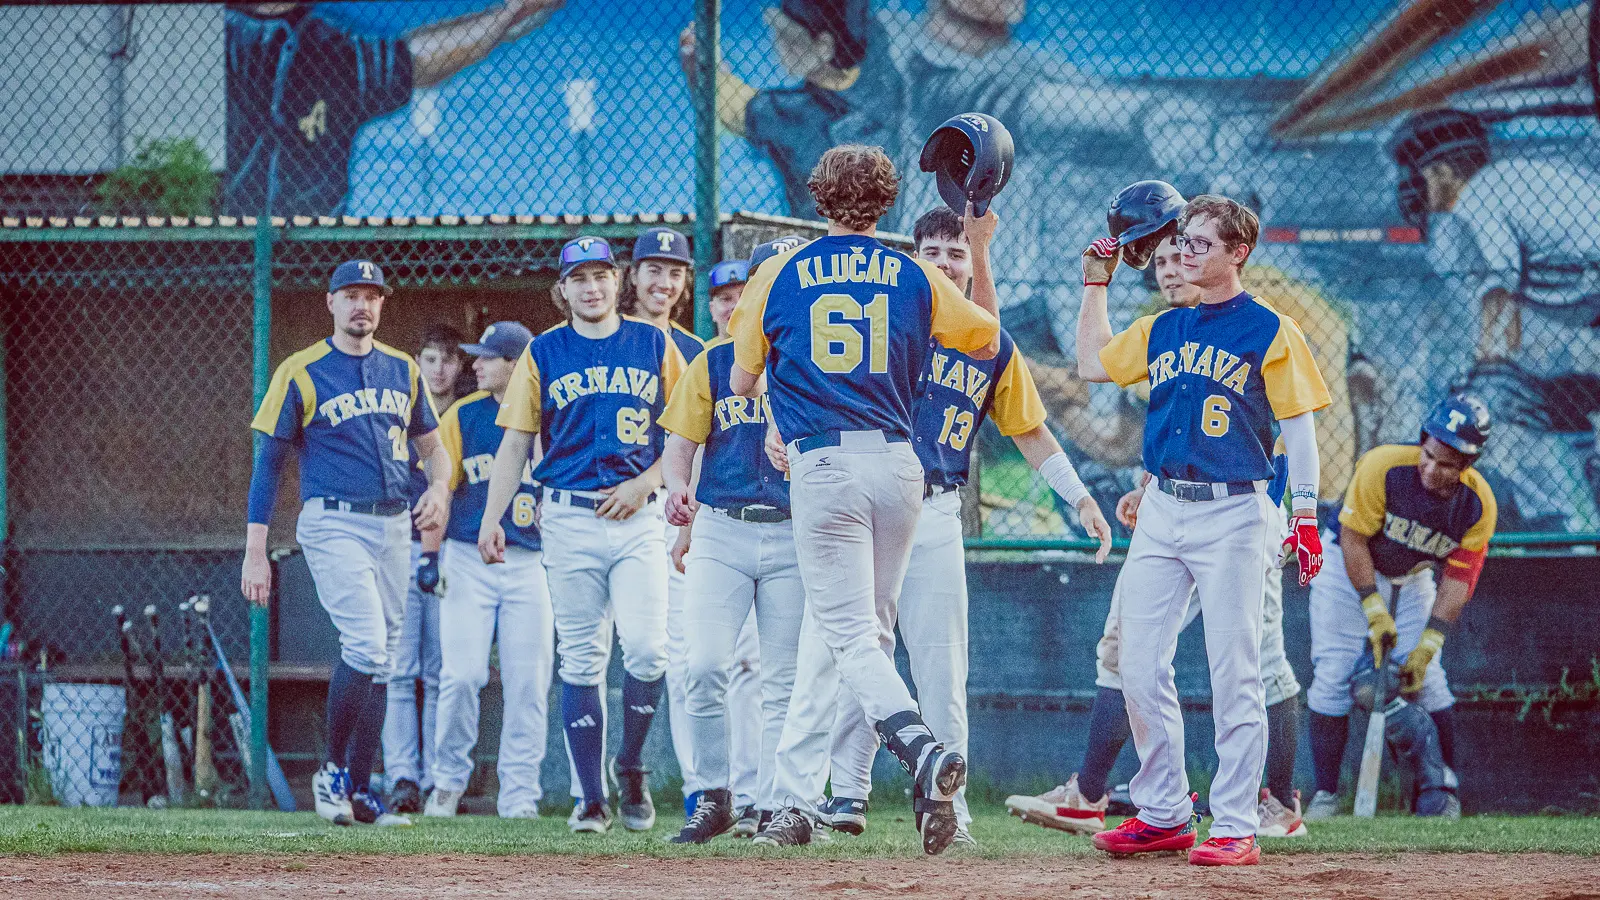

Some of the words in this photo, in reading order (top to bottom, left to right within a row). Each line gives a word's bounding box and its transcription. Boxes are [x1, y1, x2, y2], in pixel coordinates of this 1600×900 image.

[657, 232, 675, 251] T
[358, 262, 374, 280] T
[796, 247, 902, 289] KLUČÁR
[810, 294, 888, 373] 61
[548, 366, 658, 410] TRNAVA
[919, 352, 990, 410] NAVA
[1148, 341, 1251, 395] TRNAVA
[617, 407, 650, 446] 62
[714, 394, 771, 431] TRN
[938, 405, 974, 451] 13
[1201, 395, 1231, 437] 6
[1446, 409, 1466, 433] T
[1384, 512, 1459, 559] RNAV
